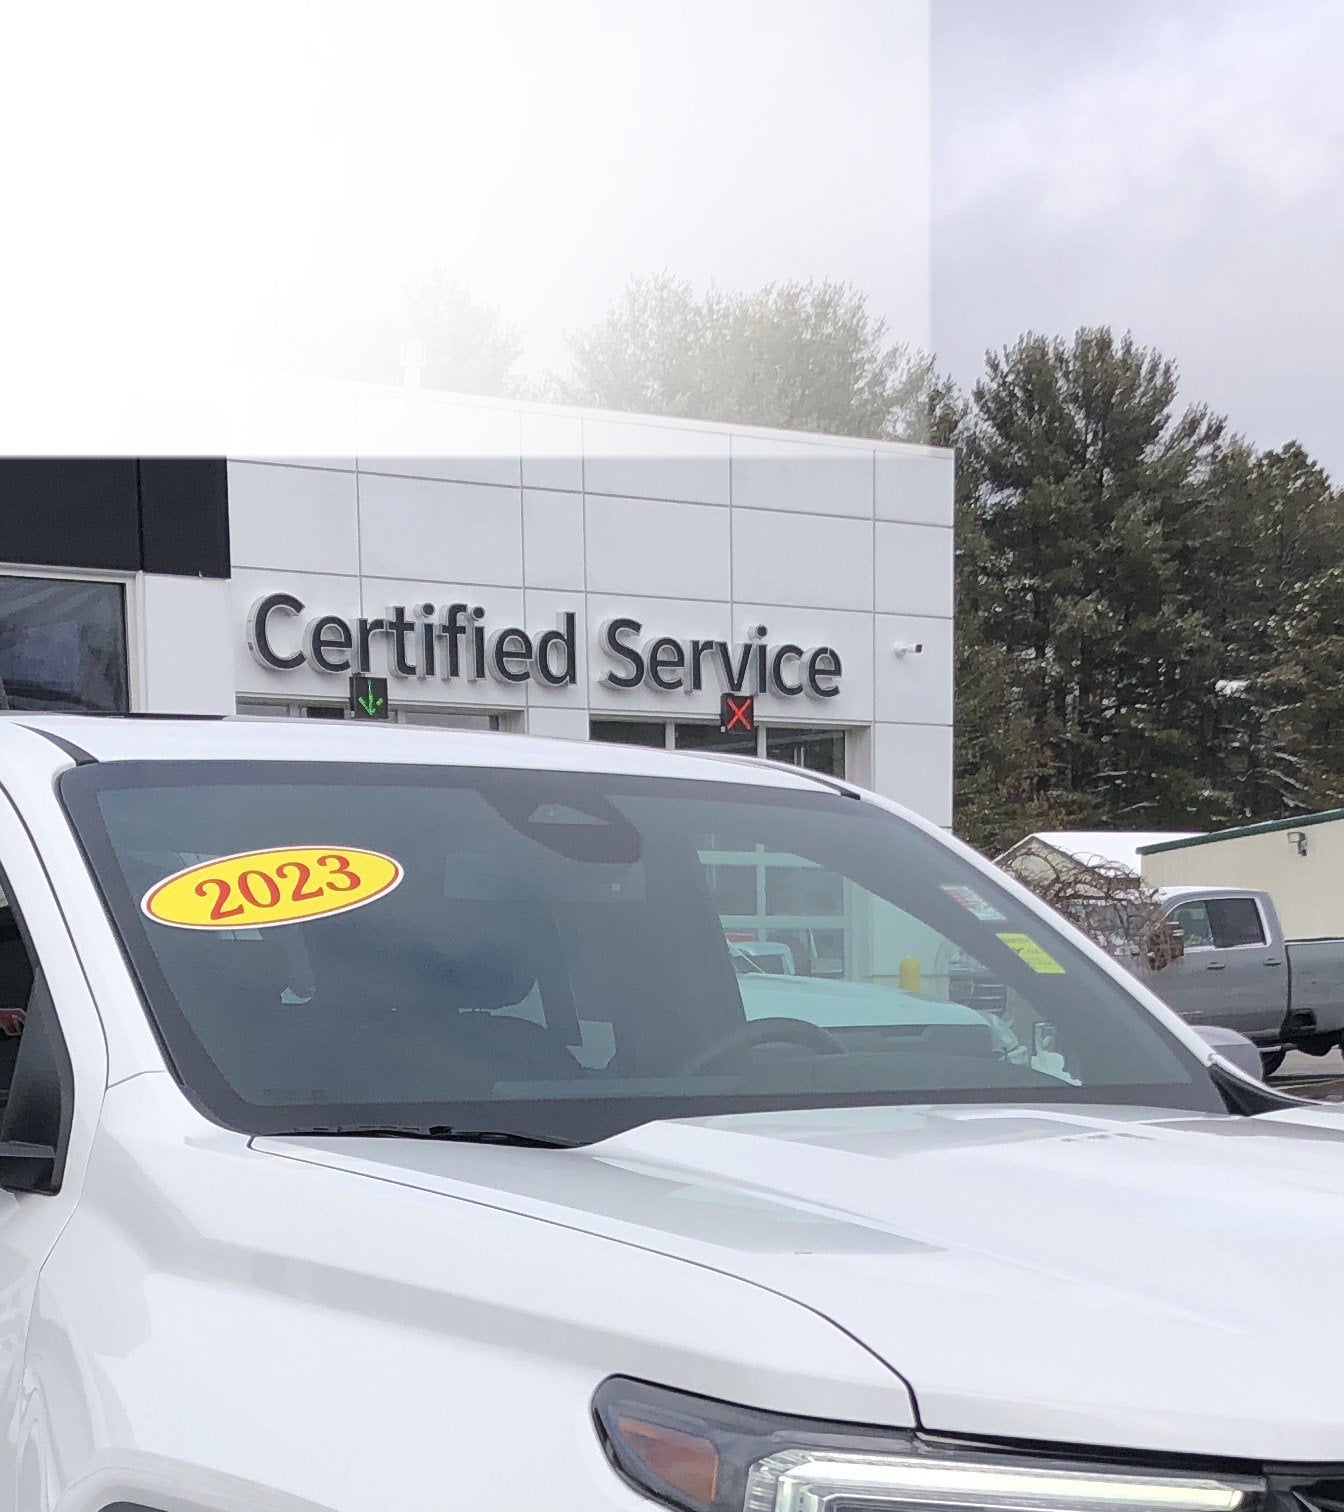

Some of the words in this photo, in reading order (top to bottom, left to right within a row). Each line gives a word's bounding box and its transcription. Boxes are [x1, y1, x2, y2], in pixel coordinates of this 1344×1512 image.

[246, 592, 578, 686] Certified
[597, 617, 843, 699] Service
[194, 854, 361, 921] 2023
